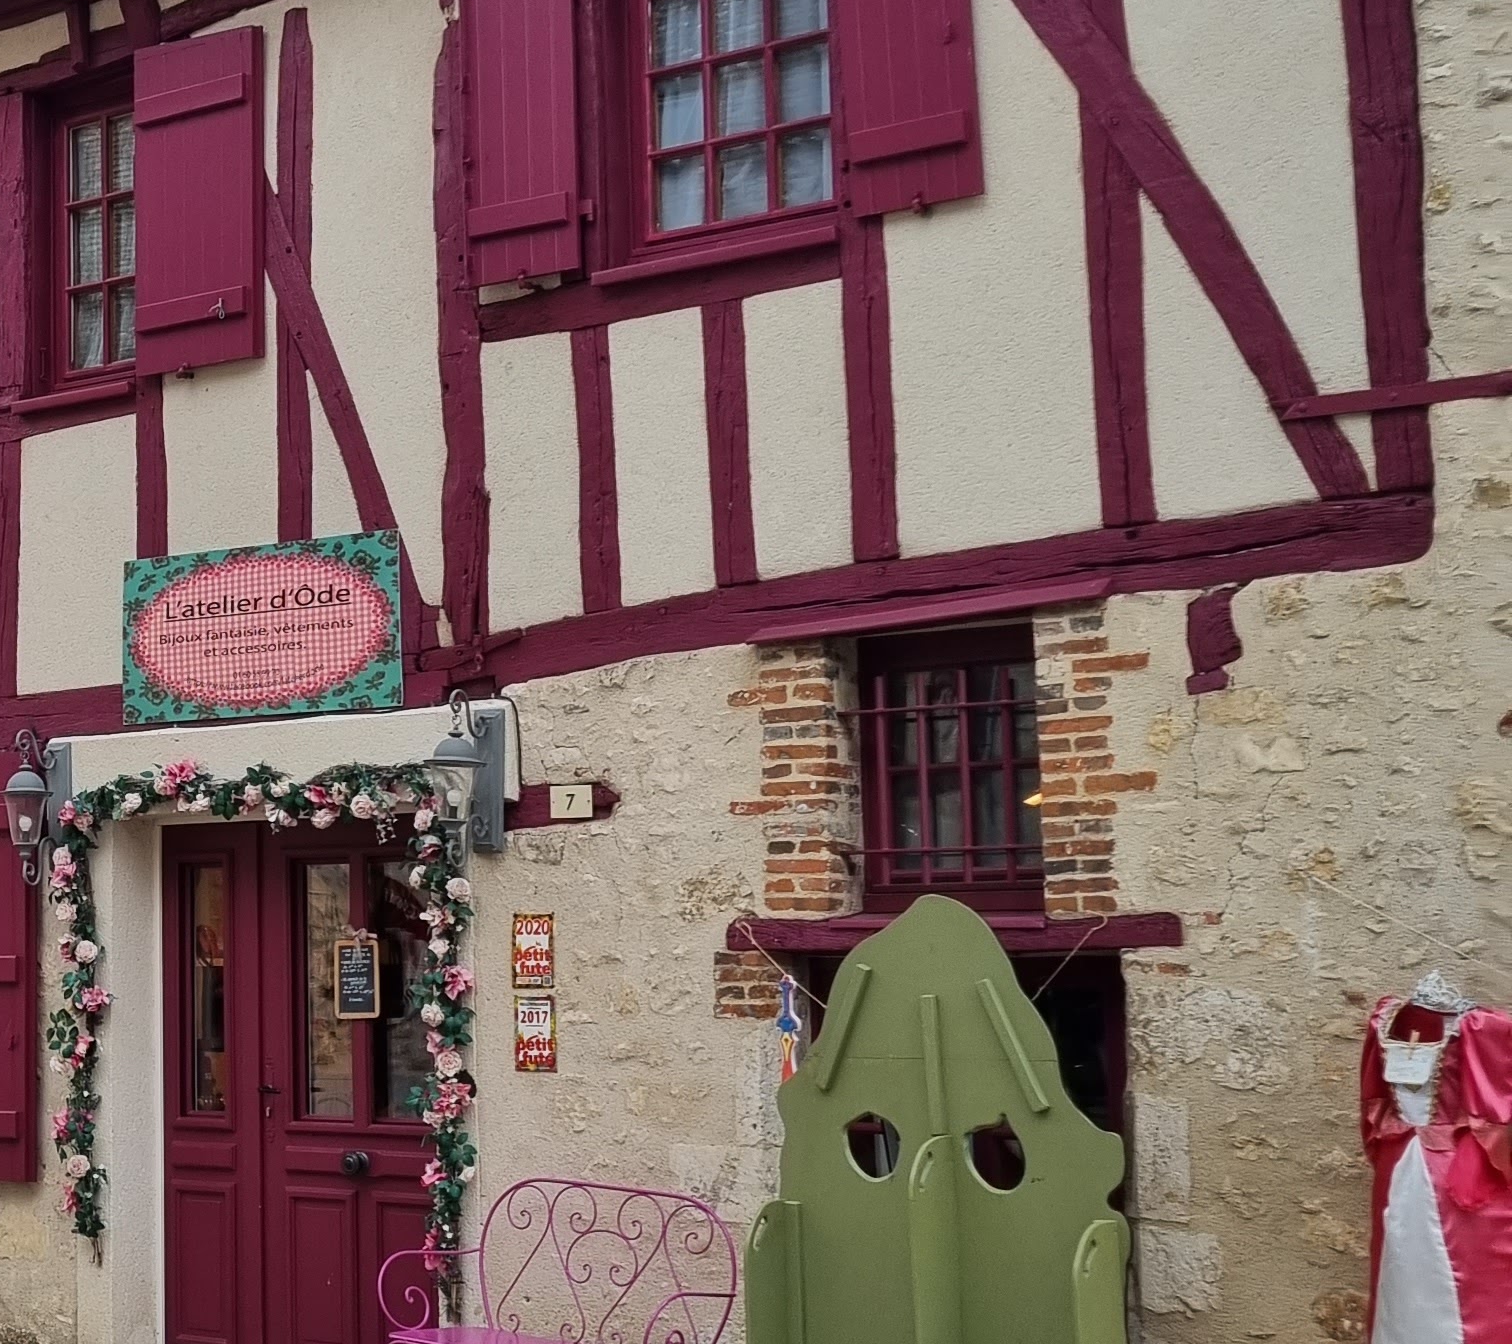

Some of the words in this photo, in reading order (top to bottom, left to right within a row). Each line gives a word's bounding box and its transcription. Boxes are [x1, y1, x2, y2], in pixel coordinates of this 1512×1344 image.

[165, 594, 263, 620] L'atelier
[269, 583, 351, 609] d'Ôde
[159, 633, 202, 647] Bijoux
[206, 625, 270, 641] fantaisie,
[273, 618, 354, 635] vêtements
[203, 647, 219, 658] et
[220, 639, 307, 657] accessoires.
[565, 793, 576, 811] 7
[515, 919, 550, 936] 2020
[513, 947, 553, 965] petit
[520, 1010, 549, 1024] 2017
[515, 1037, 555, 1055] petit
